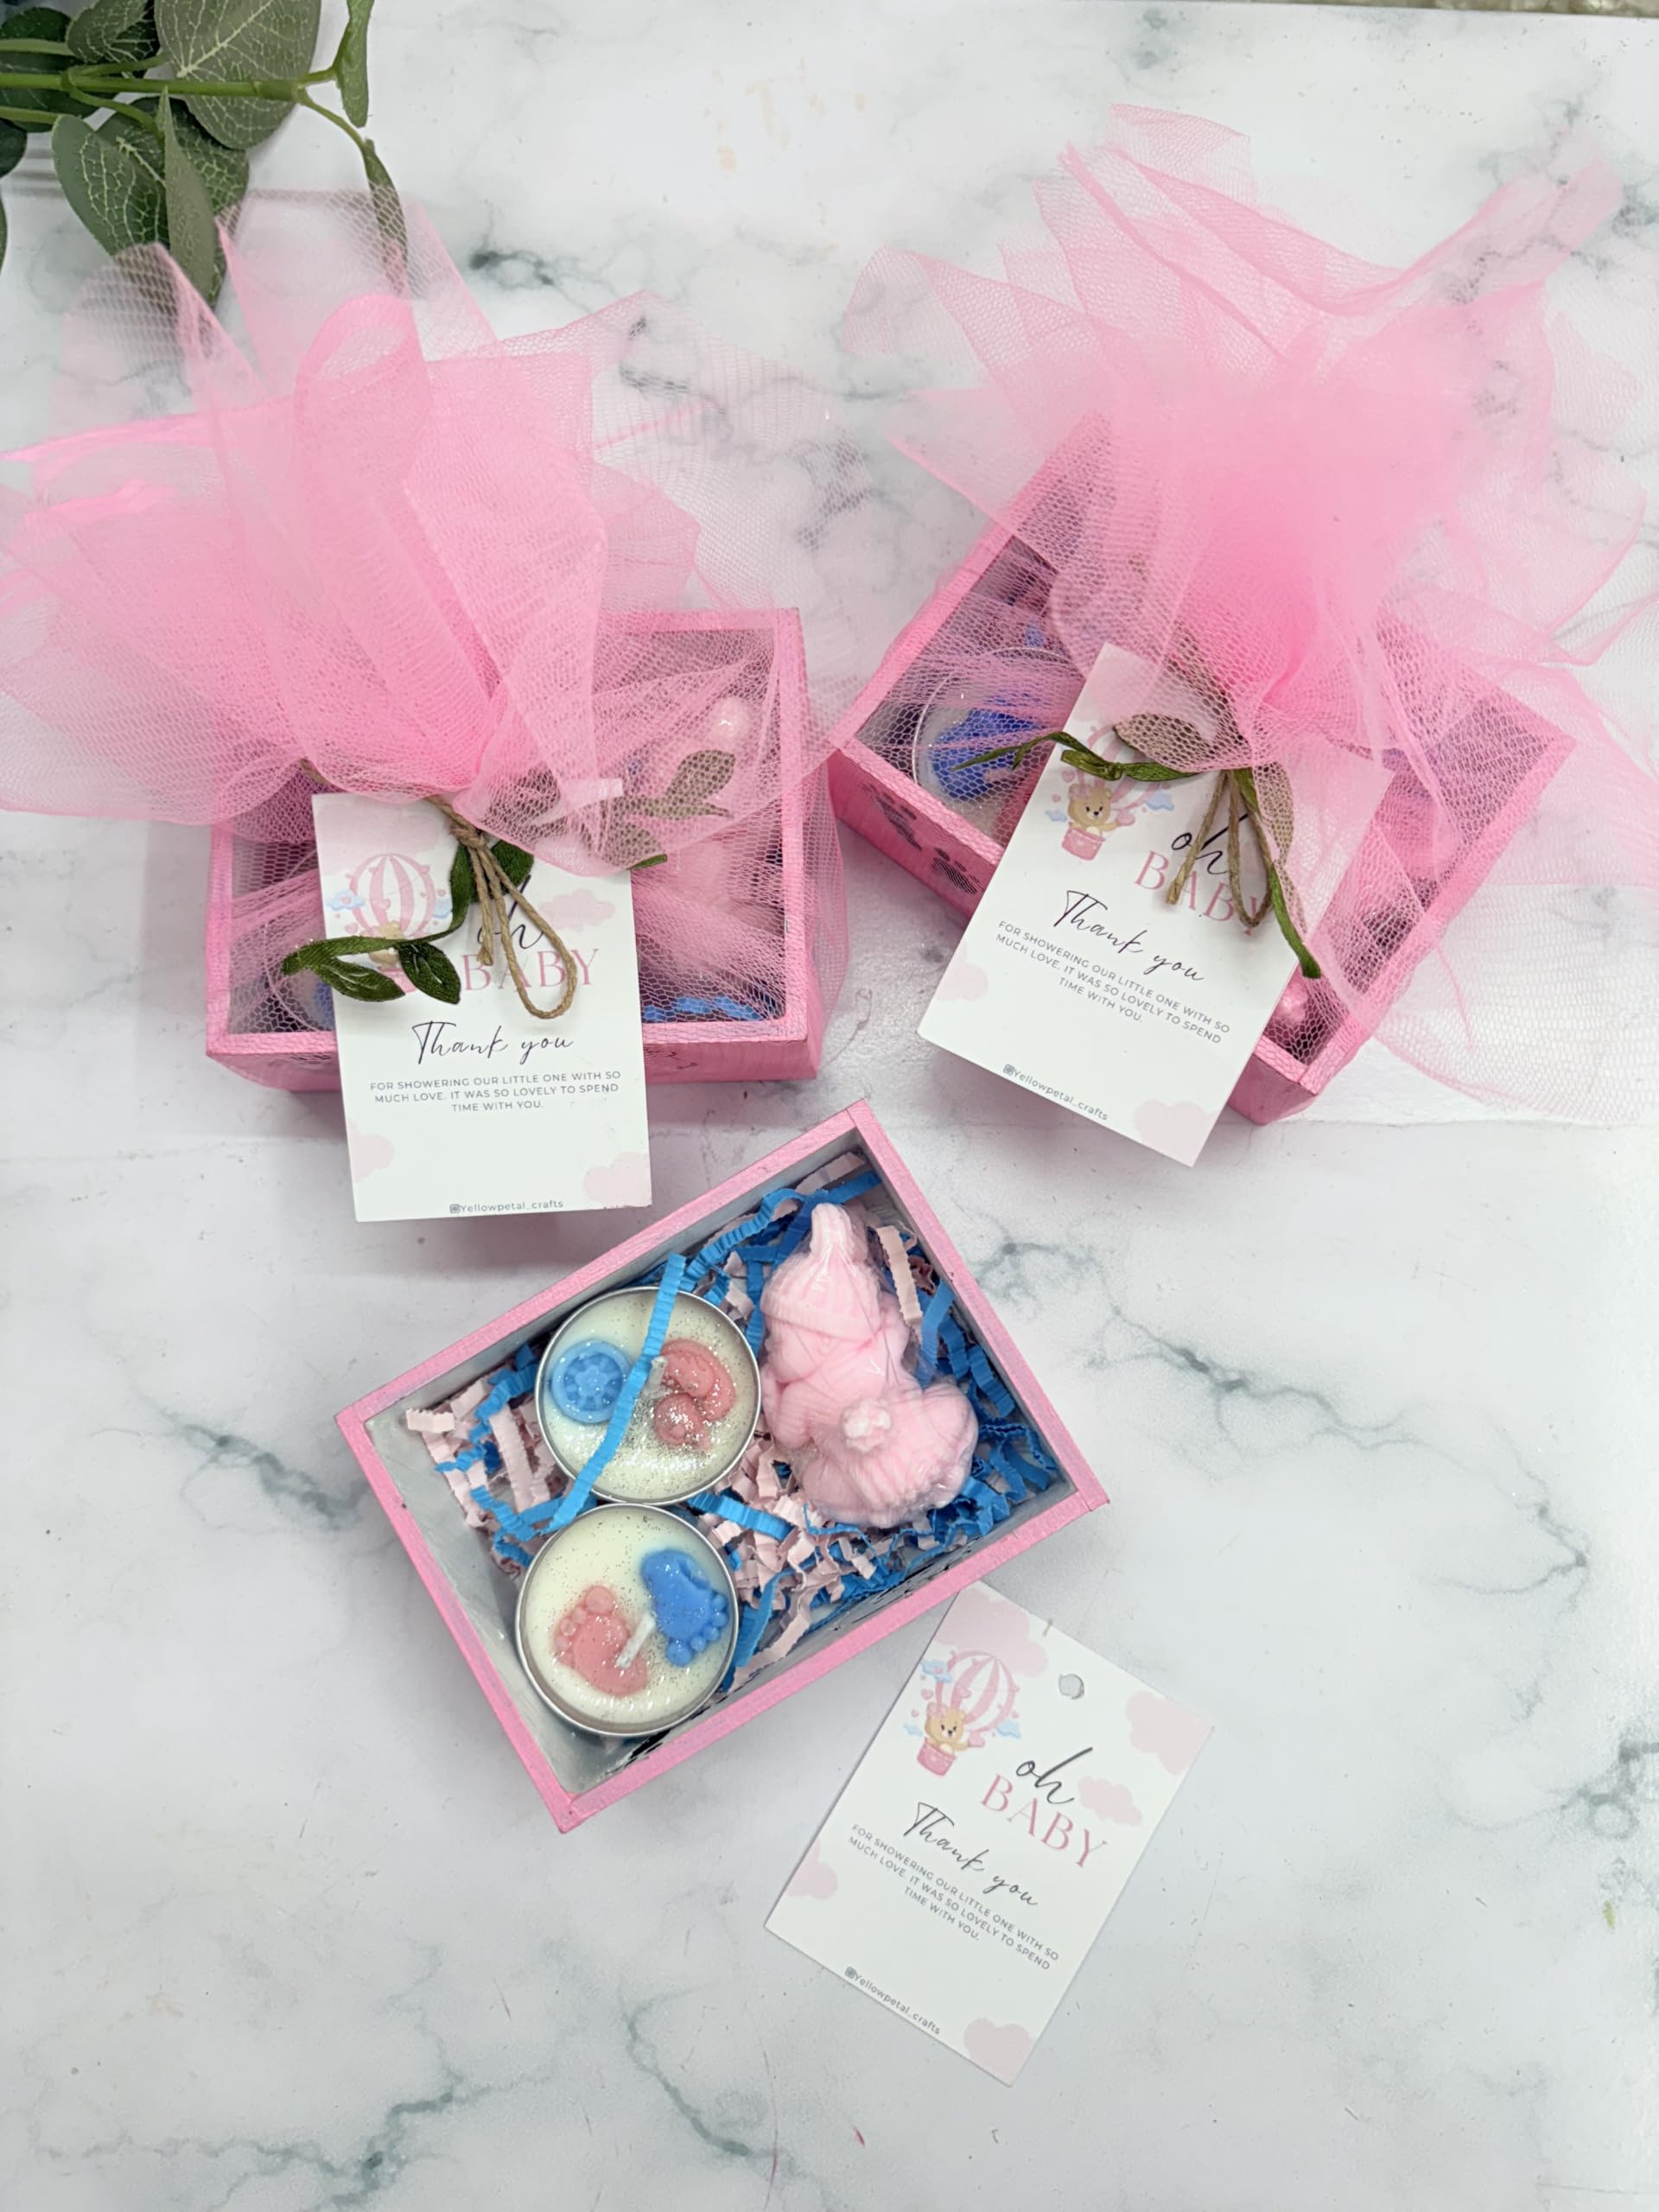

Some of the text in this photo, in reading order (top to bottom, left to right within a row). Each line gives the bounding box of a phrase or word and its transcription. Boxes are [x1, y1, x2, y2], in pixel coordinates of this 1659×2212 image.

[1171, 813, 1249, 875] oh
[1053, 891, 1205, 981] Thank you
[462, 949, 599, 992] BABY
[995, 934, 1221, 1045] MUCH LOVE. IT WAS SO LOVELY TO SPEND
[997, 920, 1230, 1034] FOR SHOWERING OUR LITTLE ONE WITH SO
[1058, 977, 1142, 1023] TIME WITH YOU.
[411, 1020, 573, 1065] Thank you
[370, 1082, 394, 1091] FOR
[397, 1078, 469, 1090] SHOWERING
[473, 1077, 499, 1086] OUR
[502, 1075, 537, 1085] LITTLE
[543, 1073, 567, 1083] ONE
[571, 1071, 601, 1081] WITH
[374, 1084, 618, 1103] MUCH LOVE. IT WAS SO LOVELY TO SPEND
[451, 1101, 543, 1113] TIME WITH YOU.
[1015, 1747, 1093, 1806] oh
[980, 1774, 1107, 1869] BABY
[903, 1802, 1038, 1905] Thank you
[848, 1836, 1051, 1970] MUCH LOVE. IT WAS SO LOVELY TO SPEND
[851, 1824, 1058, 1961] FOR SHOWERING OUR LITTLE ONE WITH SO
[903, 1885, 980, 1941] TIME WITH YOU.
